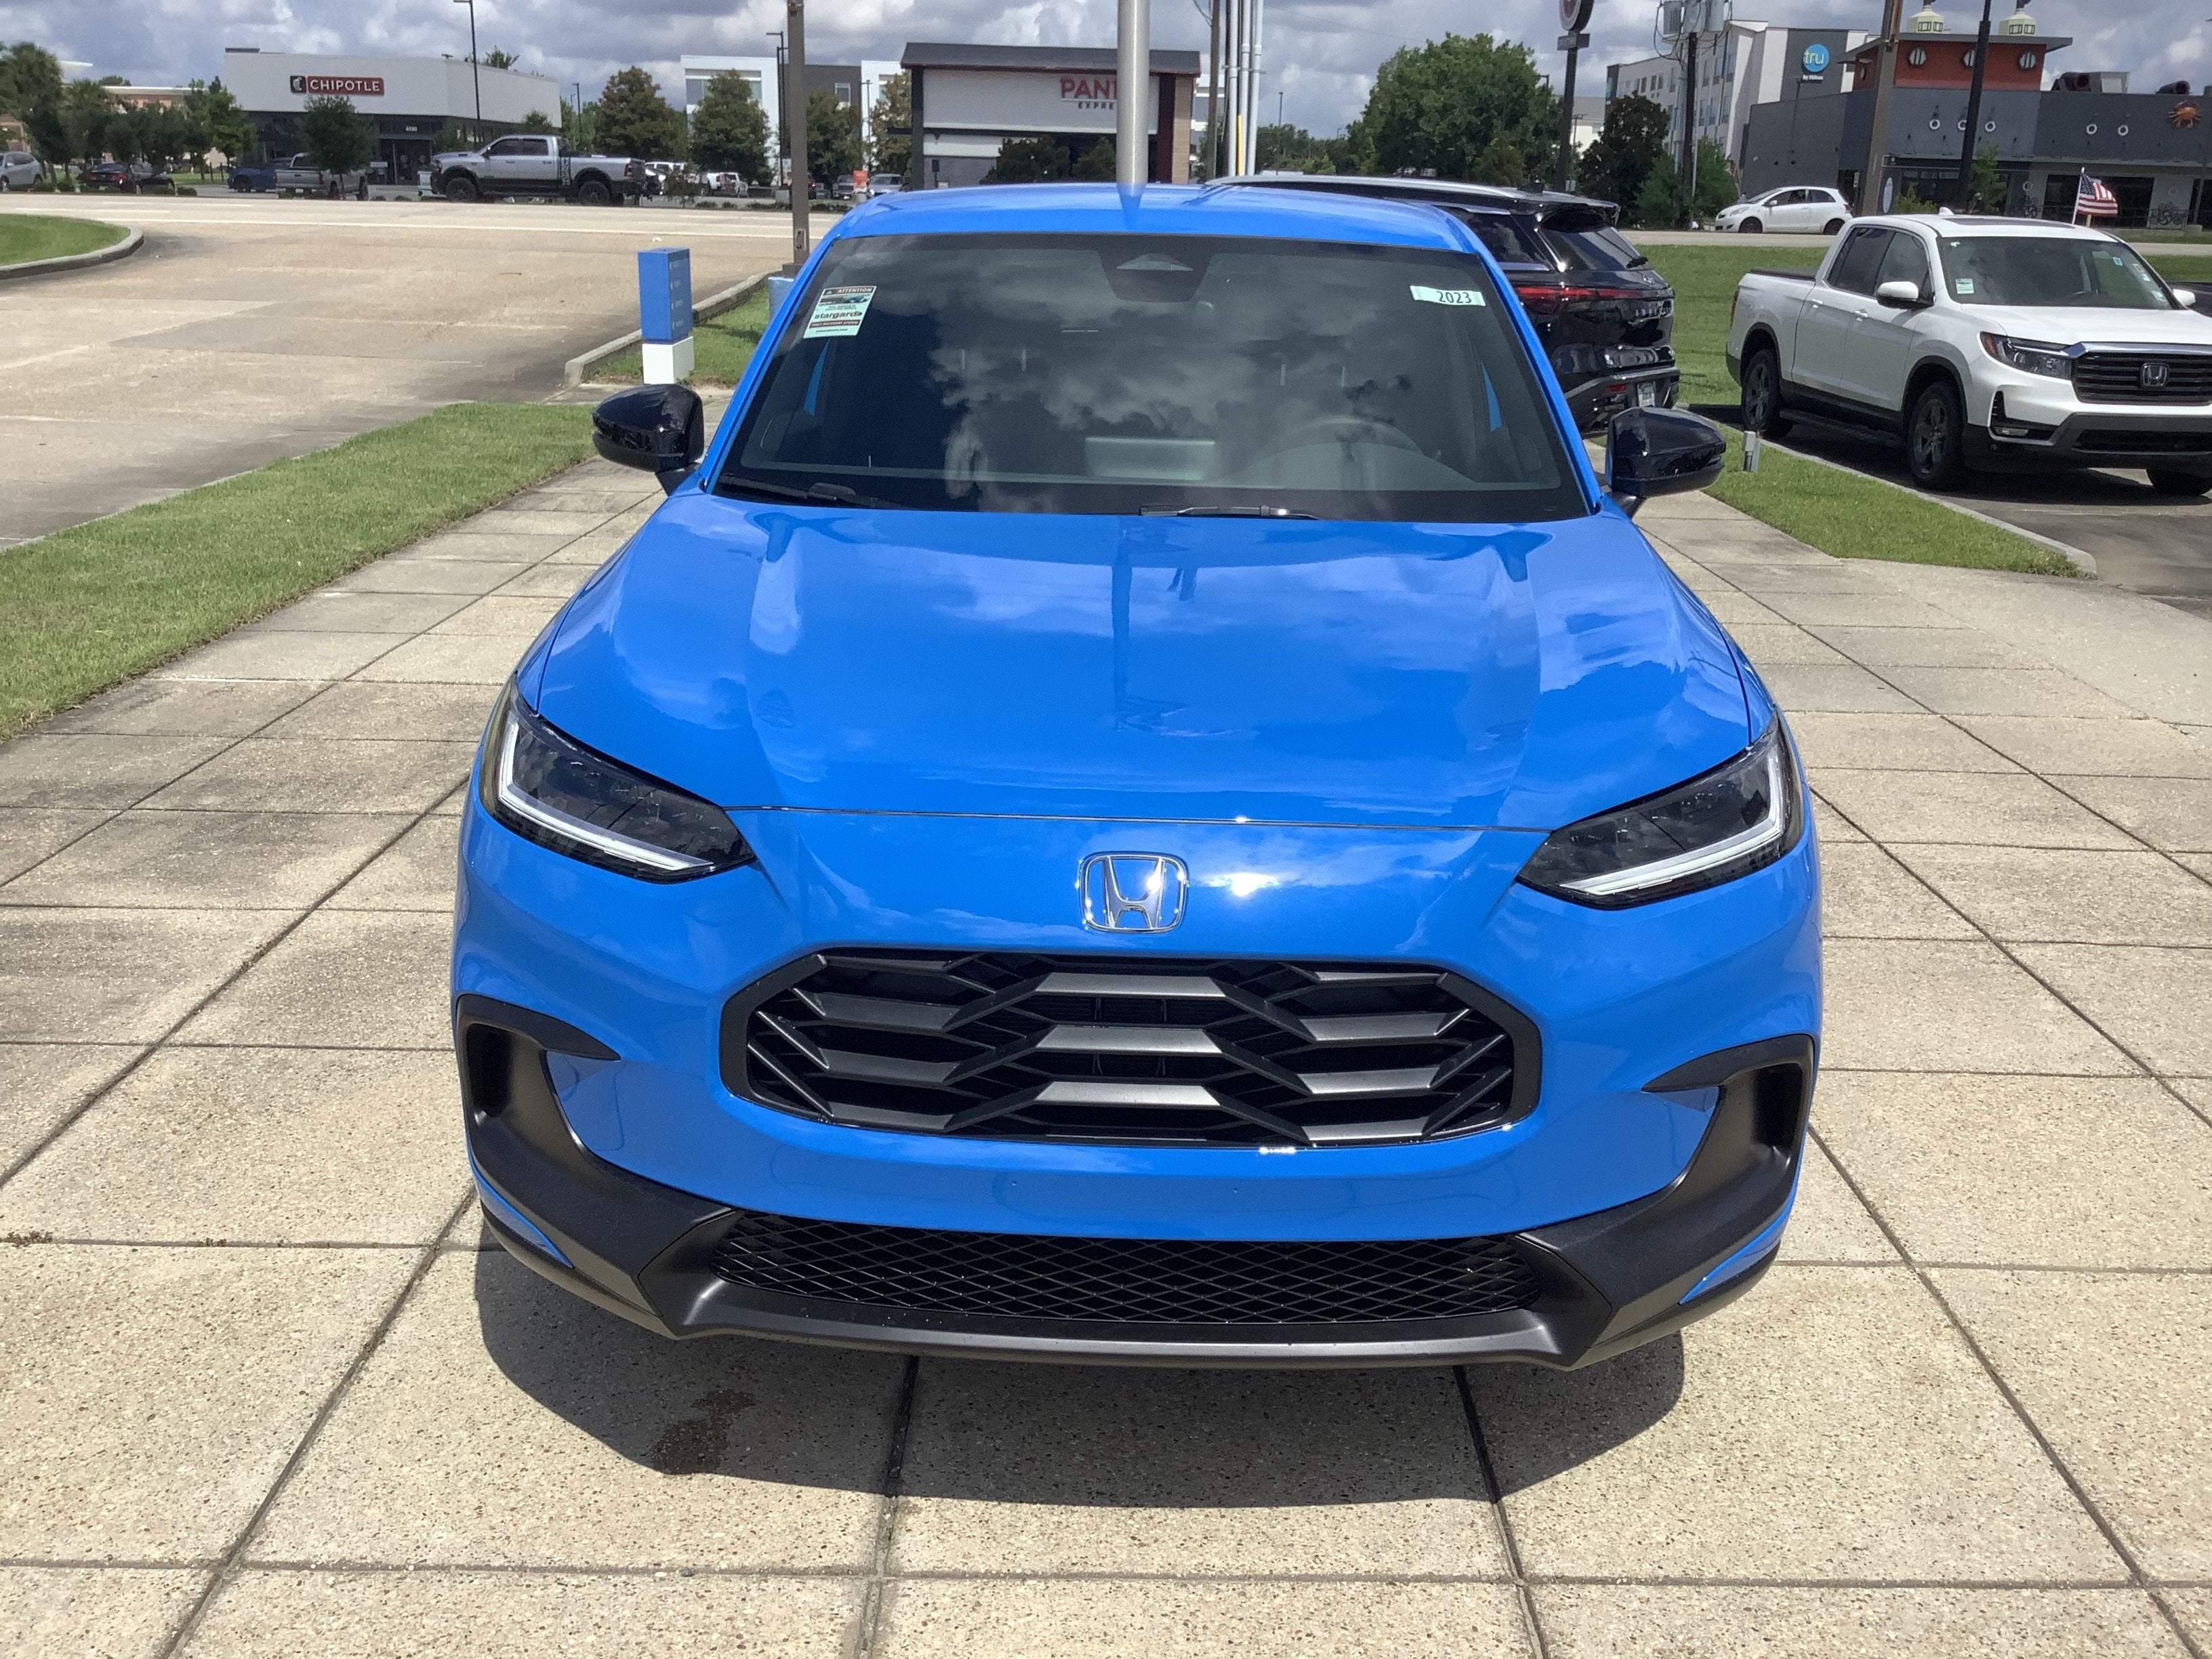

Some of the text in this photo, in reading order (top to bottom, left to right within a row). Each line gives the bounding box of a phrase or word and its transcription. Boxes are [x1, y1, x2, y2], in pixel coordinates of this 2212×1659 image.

[1804, 50, 1824, 64] tru
[310, 79, 380, 91] CHIPOTLE
[1061, 76, 1117, 99] PAN
[1436, 290, 1472, 304] 2023
